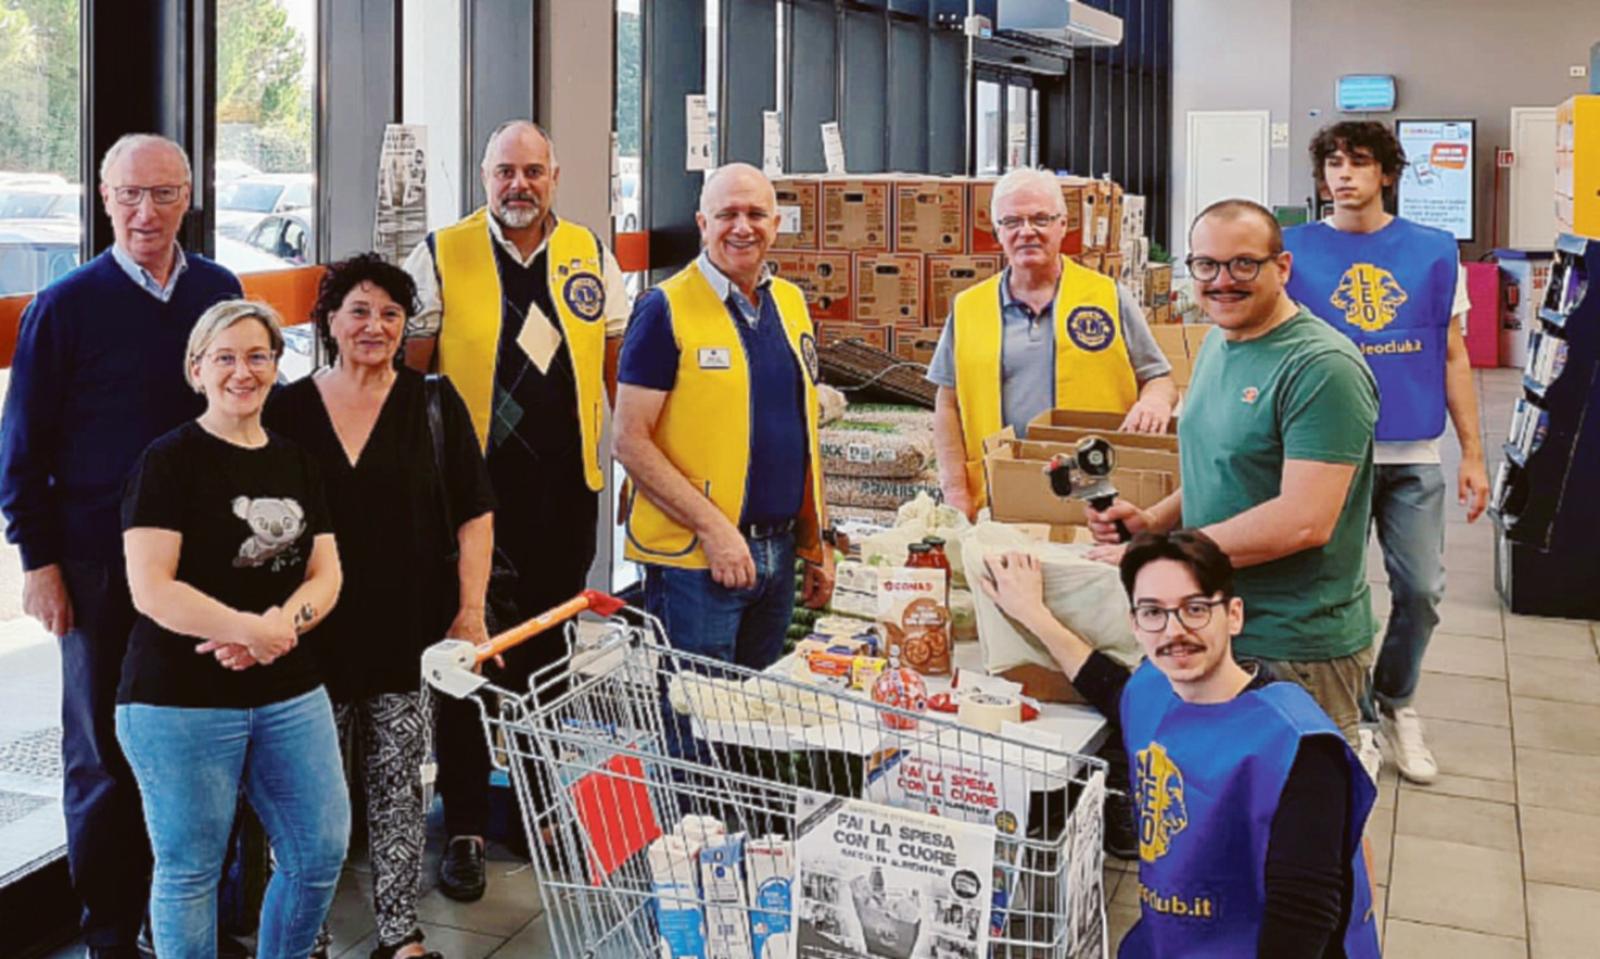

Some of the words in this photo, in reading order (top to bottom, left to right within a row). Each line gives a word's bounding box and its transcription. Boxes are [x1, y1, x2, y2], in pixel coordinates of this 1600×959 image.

[1358, 268, 1377, 322] LEO
[897, 778, 926, 793] CON
[932, 784, 943, 797] IL
[951, 788, 999, 809] CUORE
[900, 764, 923, 779] FAI
[927, 769, 944, 782] LA
[951, 774, 997, 795] SPESA
[1142, 750, 1158, 846] LEO
[833, 830, 869, 849] CON
[876, 837, 891, 853] IL
[898, 843, 957, 867] CUORE
[837, 812, 863, 831] FAI
[870, 819, 892, 836] LA
[899, 826, 955, 850] SPESA
